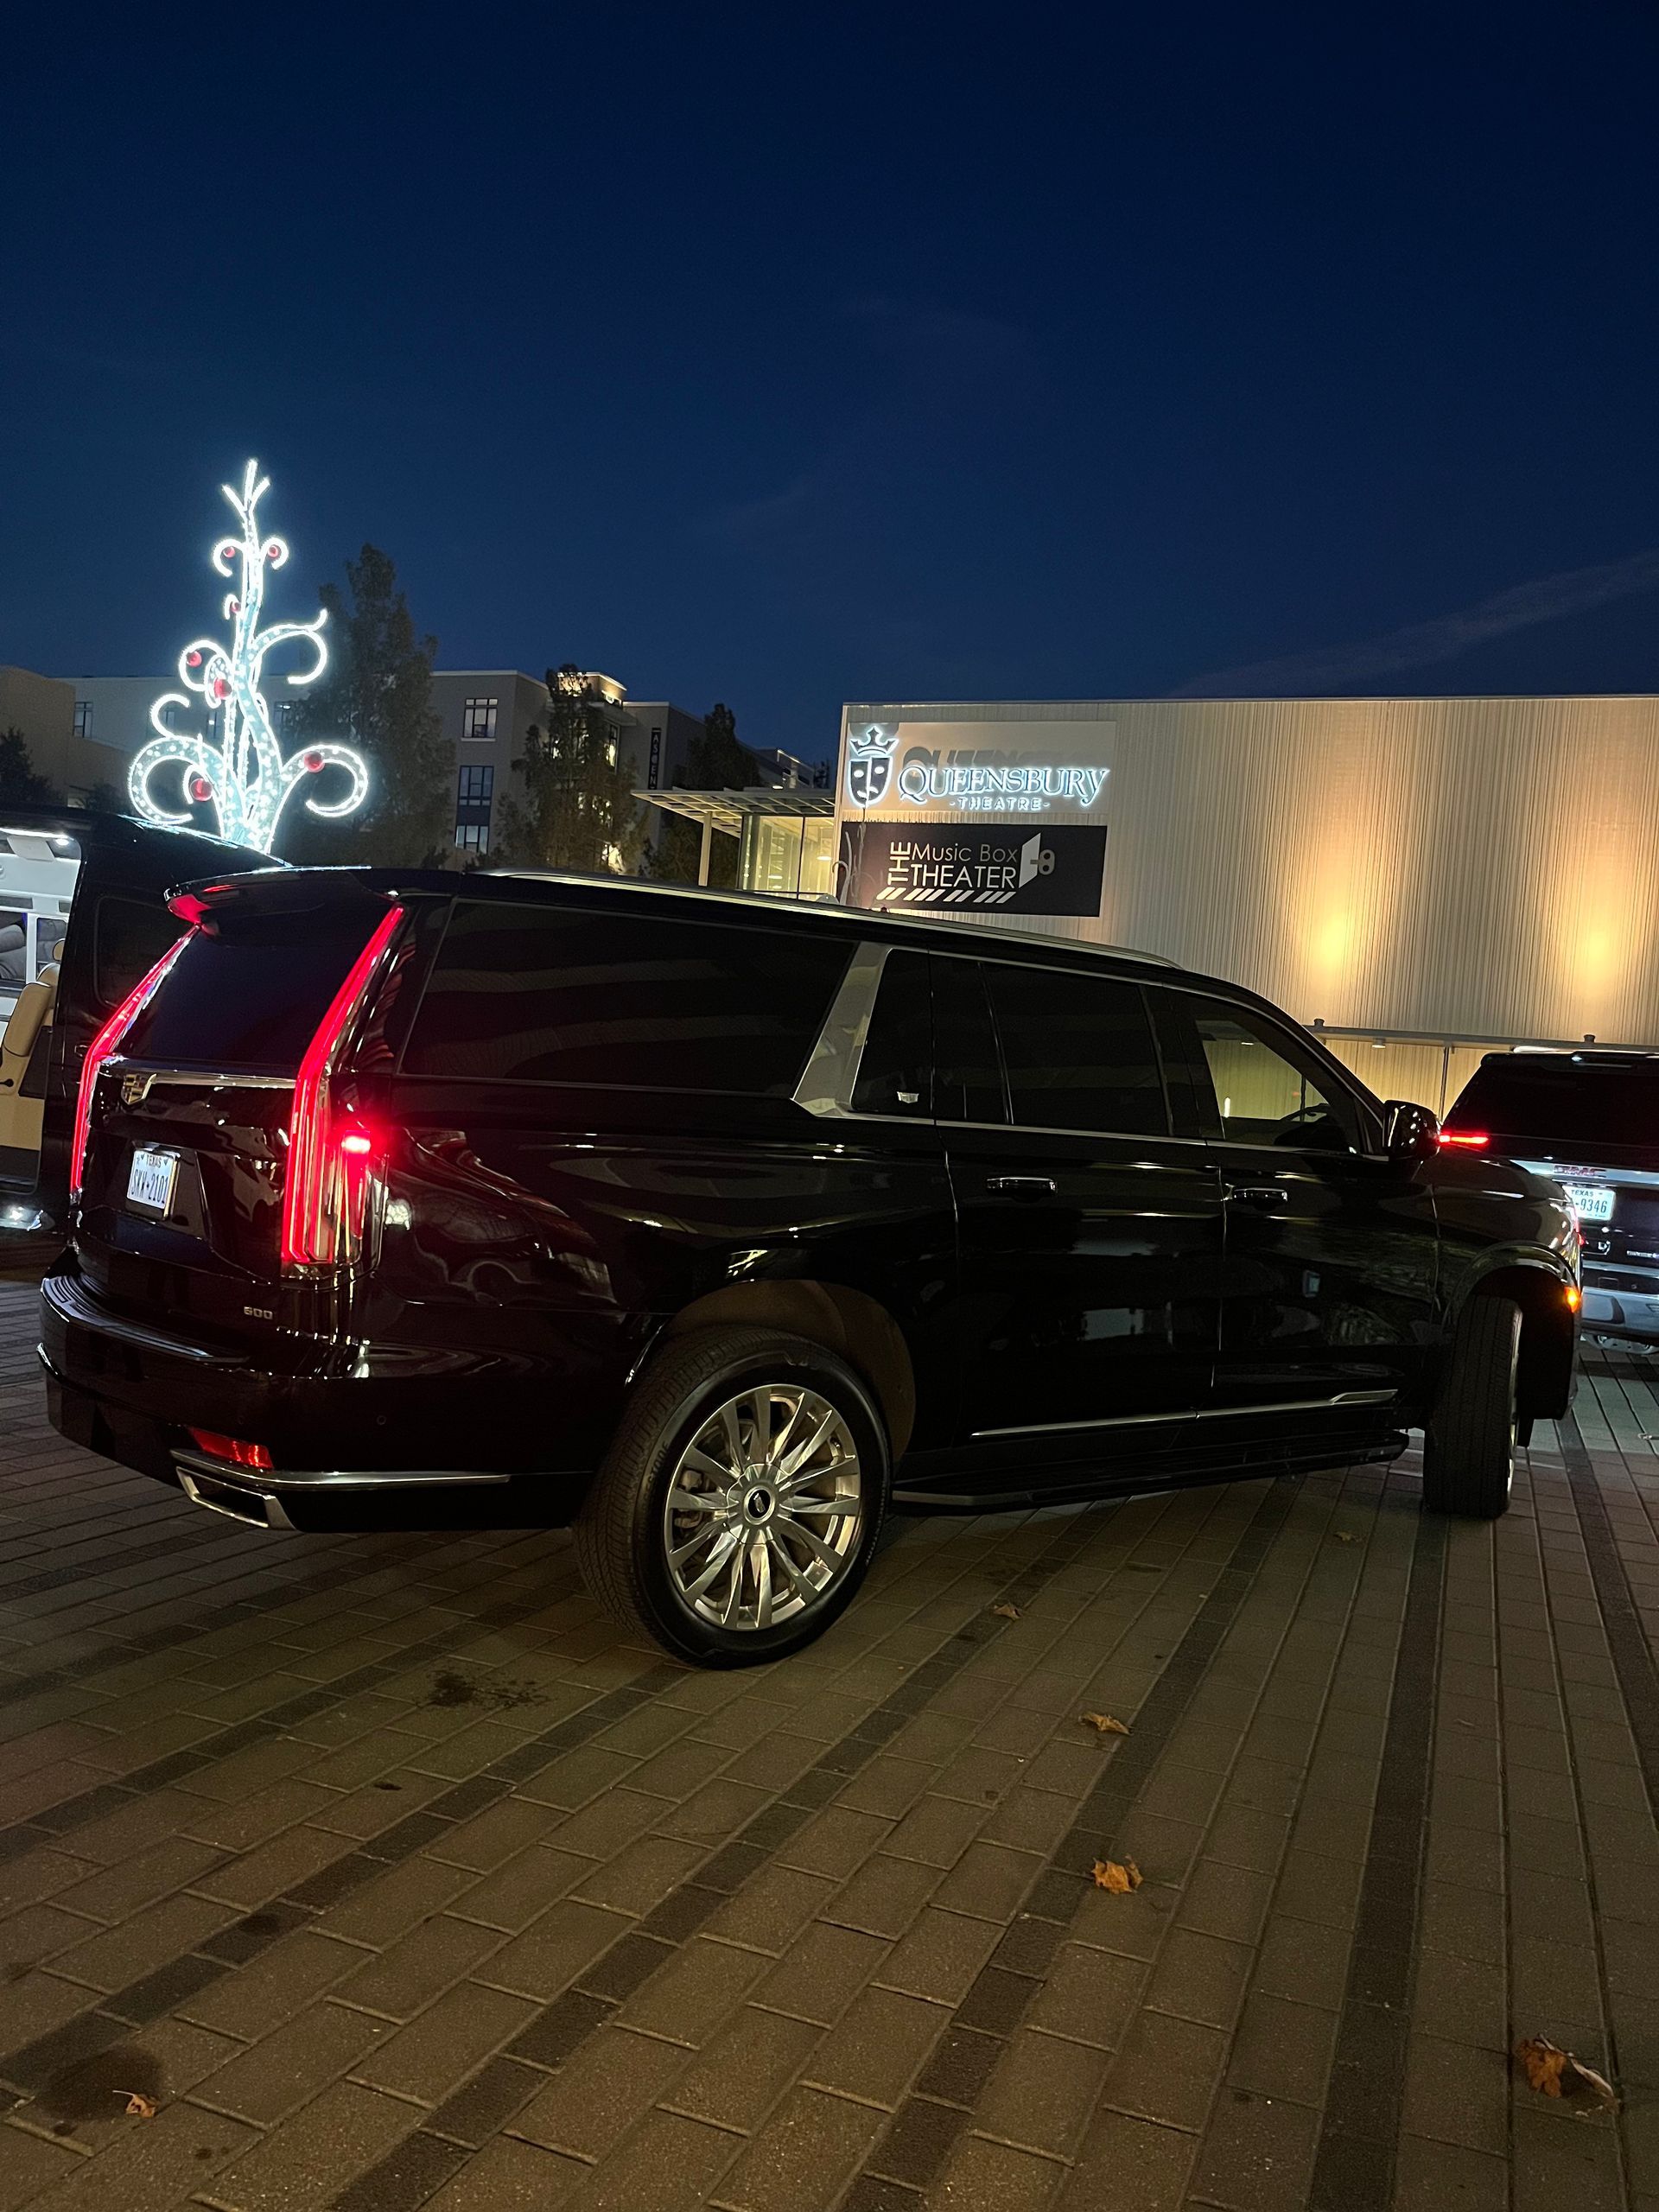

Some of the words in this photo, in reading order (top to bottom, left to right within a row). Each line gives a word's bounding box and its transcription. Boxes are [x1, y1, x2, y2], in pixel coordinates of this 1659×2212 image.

[649, 734, 659, 789] ASCEN
[898, 766, 1110, 808] QUEENSBURY
[887, 842, 911, 886] THE
[912, 842, 972, 861] Music
[979, 843, 1018, 863] Box
[911, 864, 1017, 889] THEATER
[1571, 1189, 1594, 1198] TEXAS
[244, 1306, 273, 1320] 600
